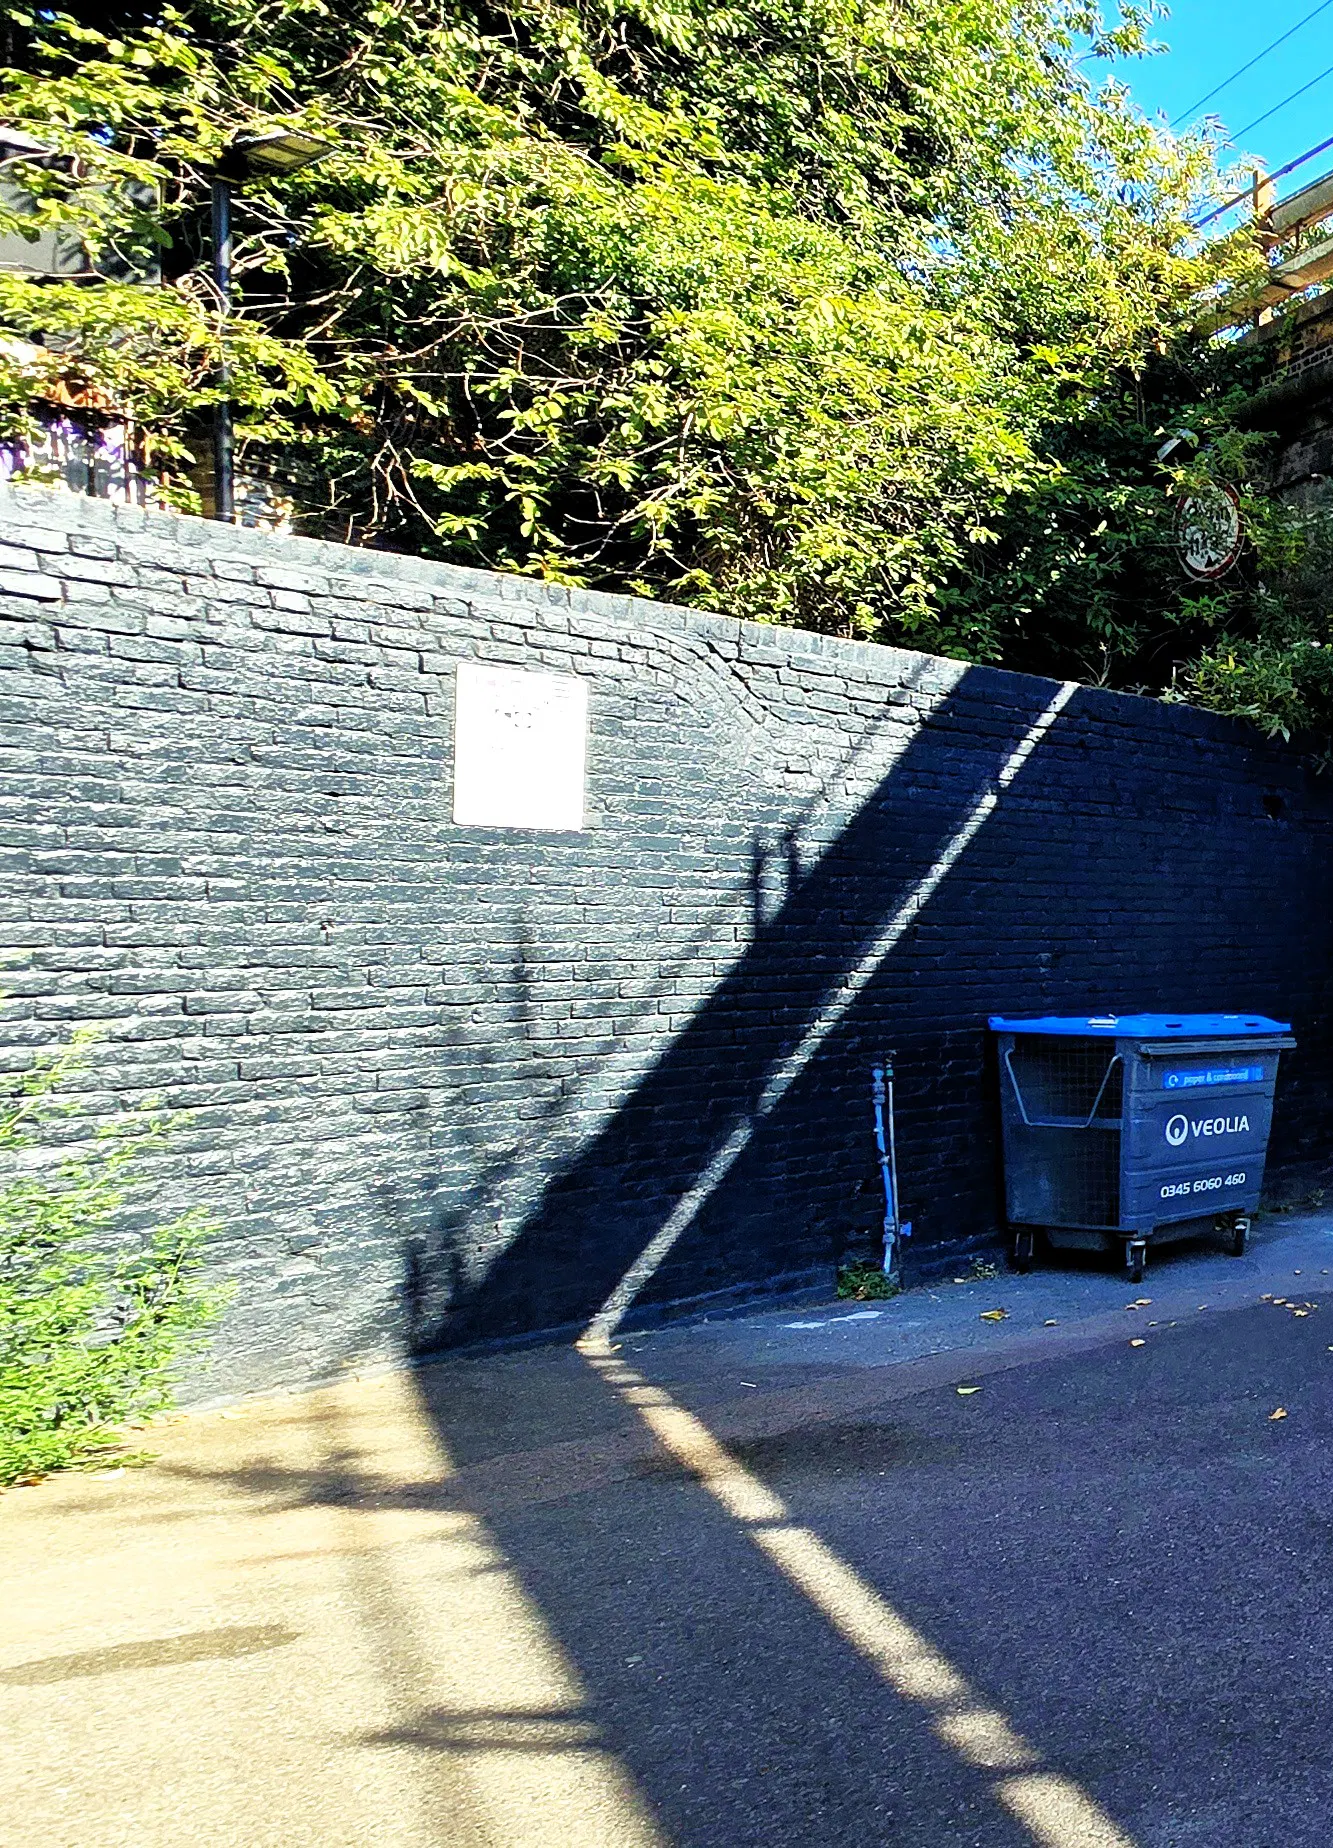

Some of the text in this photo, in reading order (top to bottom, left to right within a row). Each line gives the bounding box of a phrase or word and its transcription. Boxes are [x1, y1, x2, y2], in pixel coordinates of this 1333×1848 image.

[1191, 1115, 1250, 1138] VEOLIA
[1160, 1173, 1246, 1199] 0345 6060 460
